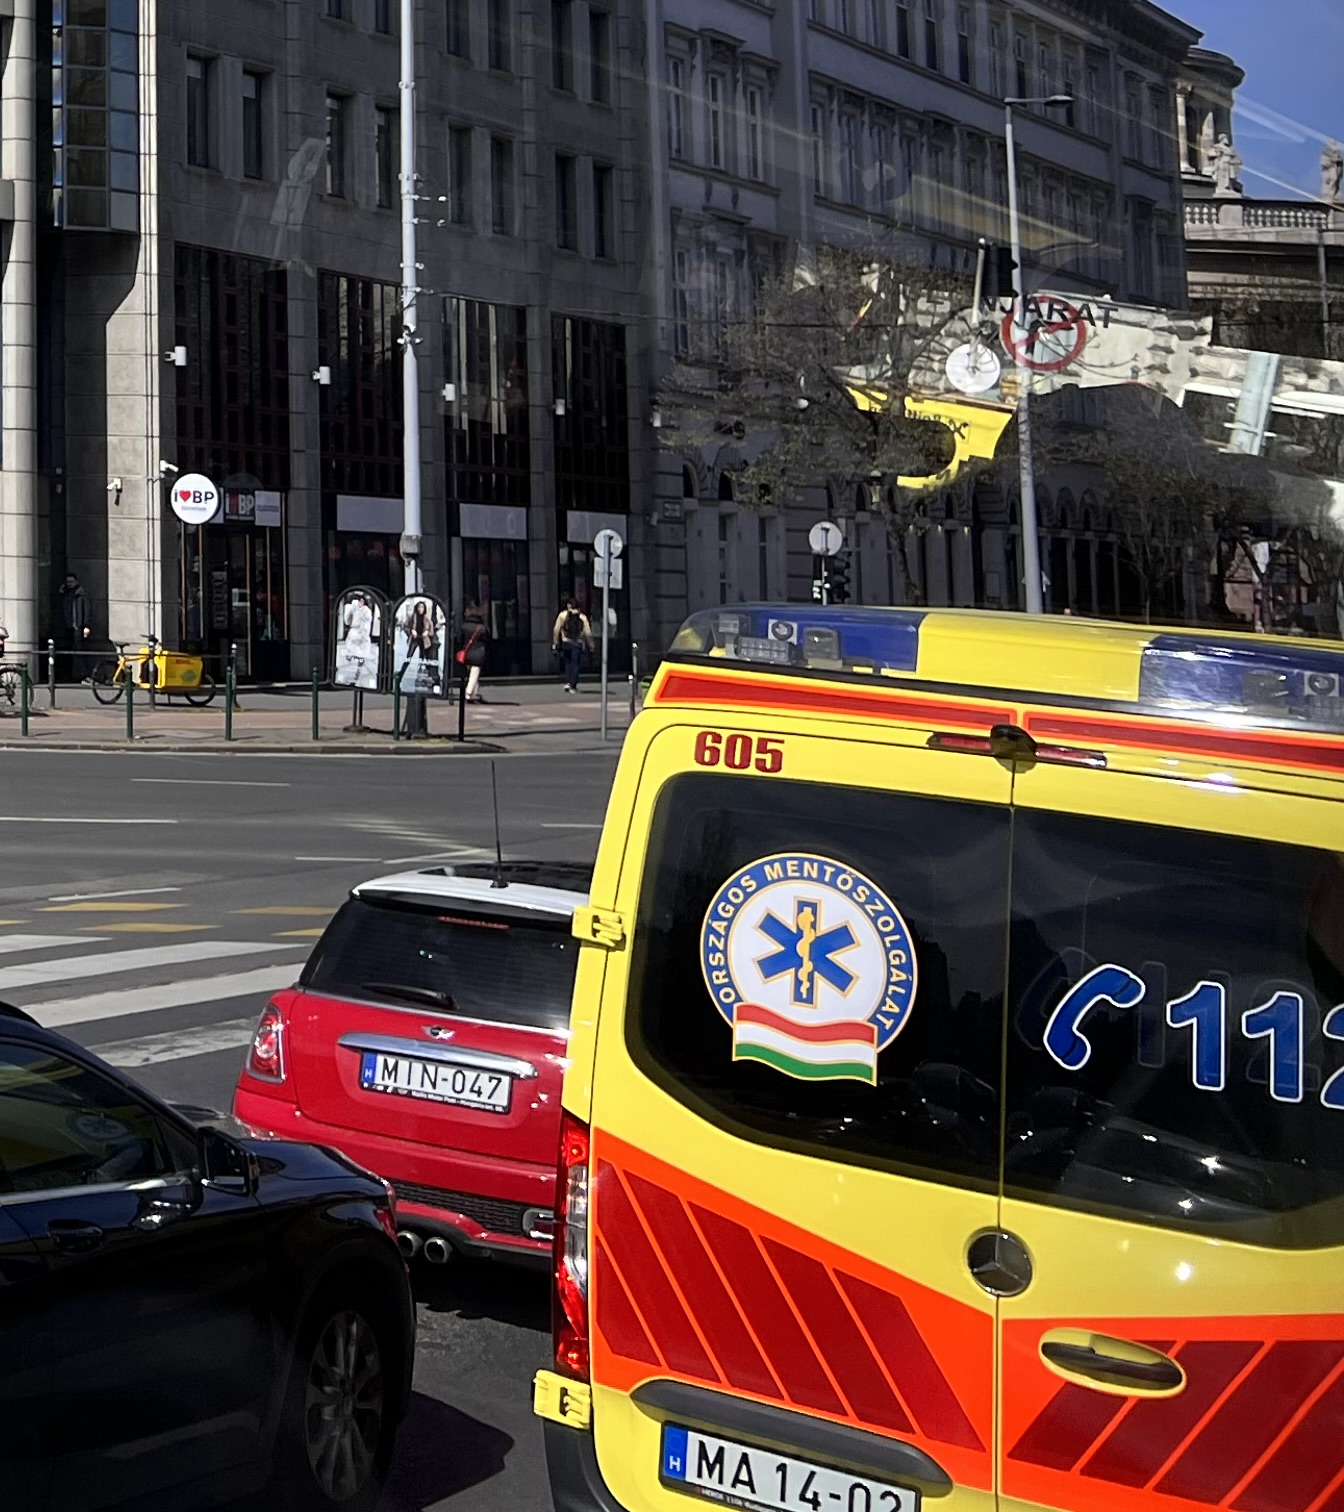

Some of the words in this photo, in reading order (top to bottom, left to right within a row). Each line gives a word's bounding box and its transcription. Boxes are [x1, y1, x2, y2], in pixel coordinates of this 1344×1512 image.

[694, 730, 786, 774] 605
[708, 874, 759, 1005] ORSZÁGOS
[763, 859, 913, 1031] MENTŐSZOLGÁLAT
[364, 1067, 373, 1080] H
[381, 1058, 503, 1101] MIN-047
[669, 1455, 681, 1472] H
[696, 1439, 757, 1495] MA
